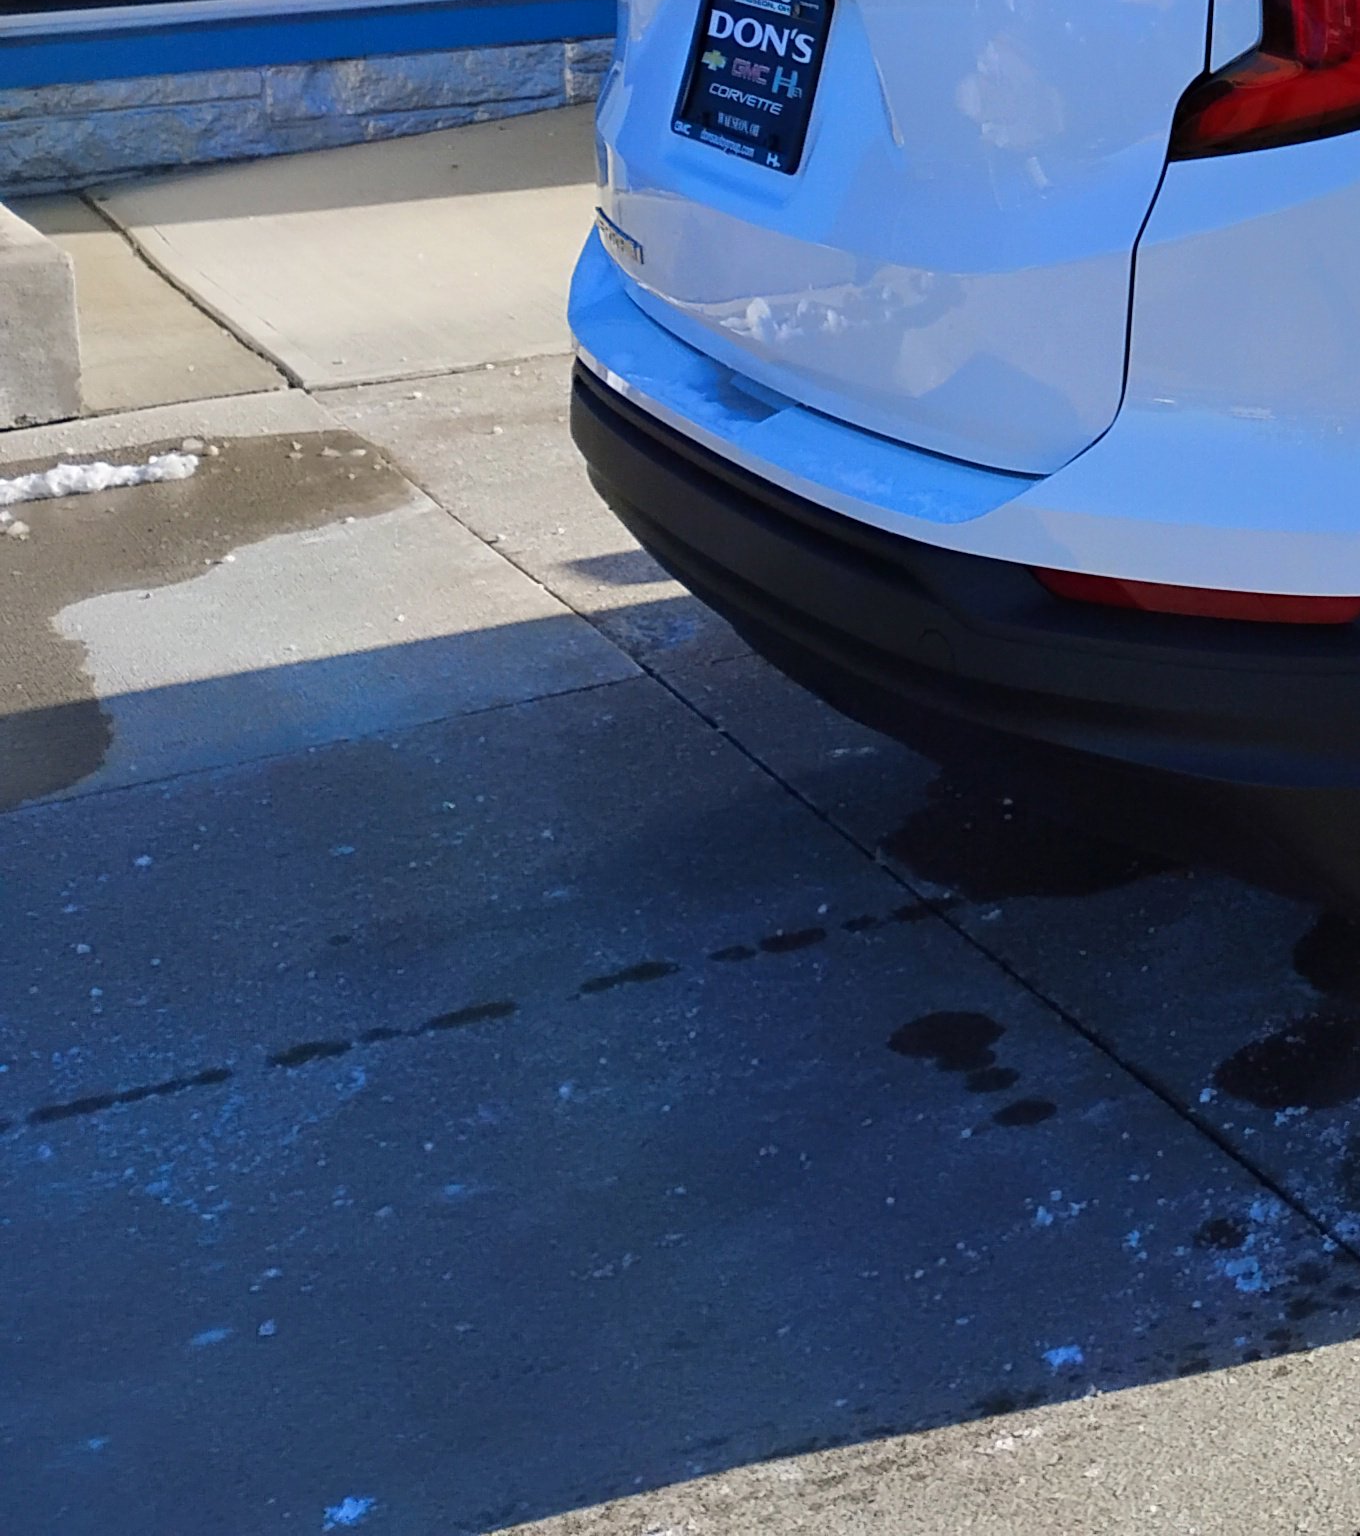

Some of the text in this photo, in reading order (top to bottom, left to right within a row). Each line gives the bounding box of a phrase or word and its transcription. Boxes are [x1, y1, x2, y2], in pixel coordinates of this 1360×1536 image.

[707, 9, 815, 64] DON'S
[731, 58, 770, 86] GMC
[709, 83, 784, 115] CORVETTE
